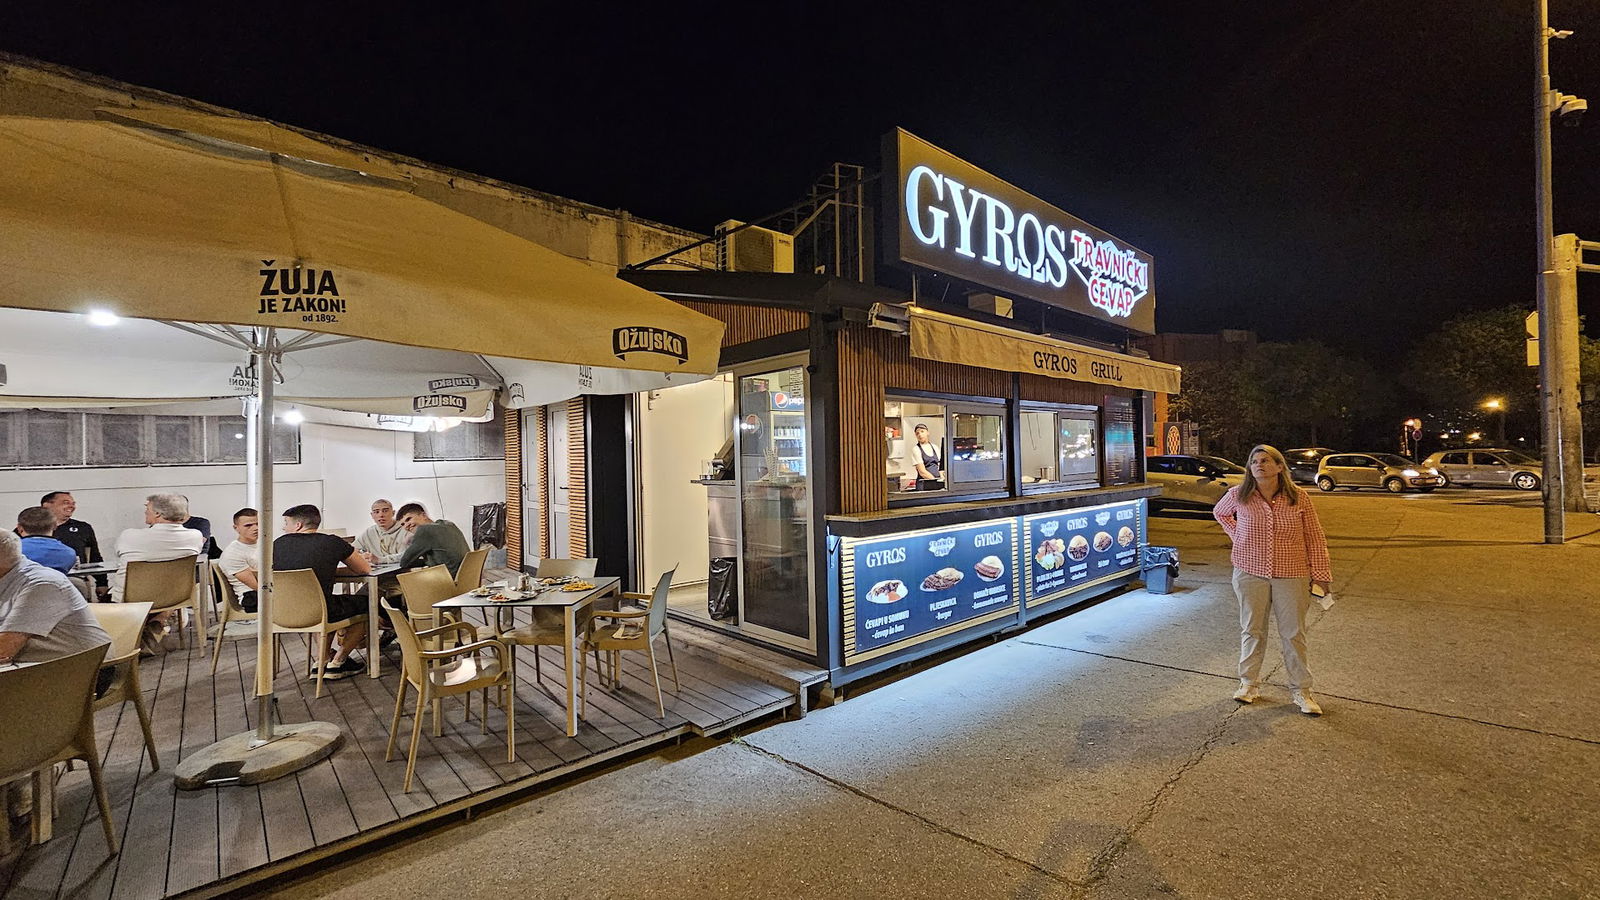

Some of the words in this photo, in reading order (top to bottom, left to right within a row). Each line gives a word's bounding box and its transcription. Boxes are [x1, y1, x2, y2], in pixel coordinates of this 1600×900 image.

[905, 165, 1068, 288] GYROS
[1071, 231, 1148, 291] TRAVNIČKI
[260, 259, 340, 297] ŽUJA
[258, 298, 278, 314] JE
[282, 297, 347, 313] ZAKON!
[302, 313, 314, 322] od
[315, 313, 339, 323] 1892.
[618, 327, 683, 355] Ožujsko
[1033, 351, 1078, 375] GYROS
[1091, 361, 1123, 382] GRILL
[417, 394, 464, 408] Ožujsko
[1067, 517, 1088, 531] GYROS
[974, 531, 1004, 548] GYROS
[866, 547, 906, 568] GYROS
